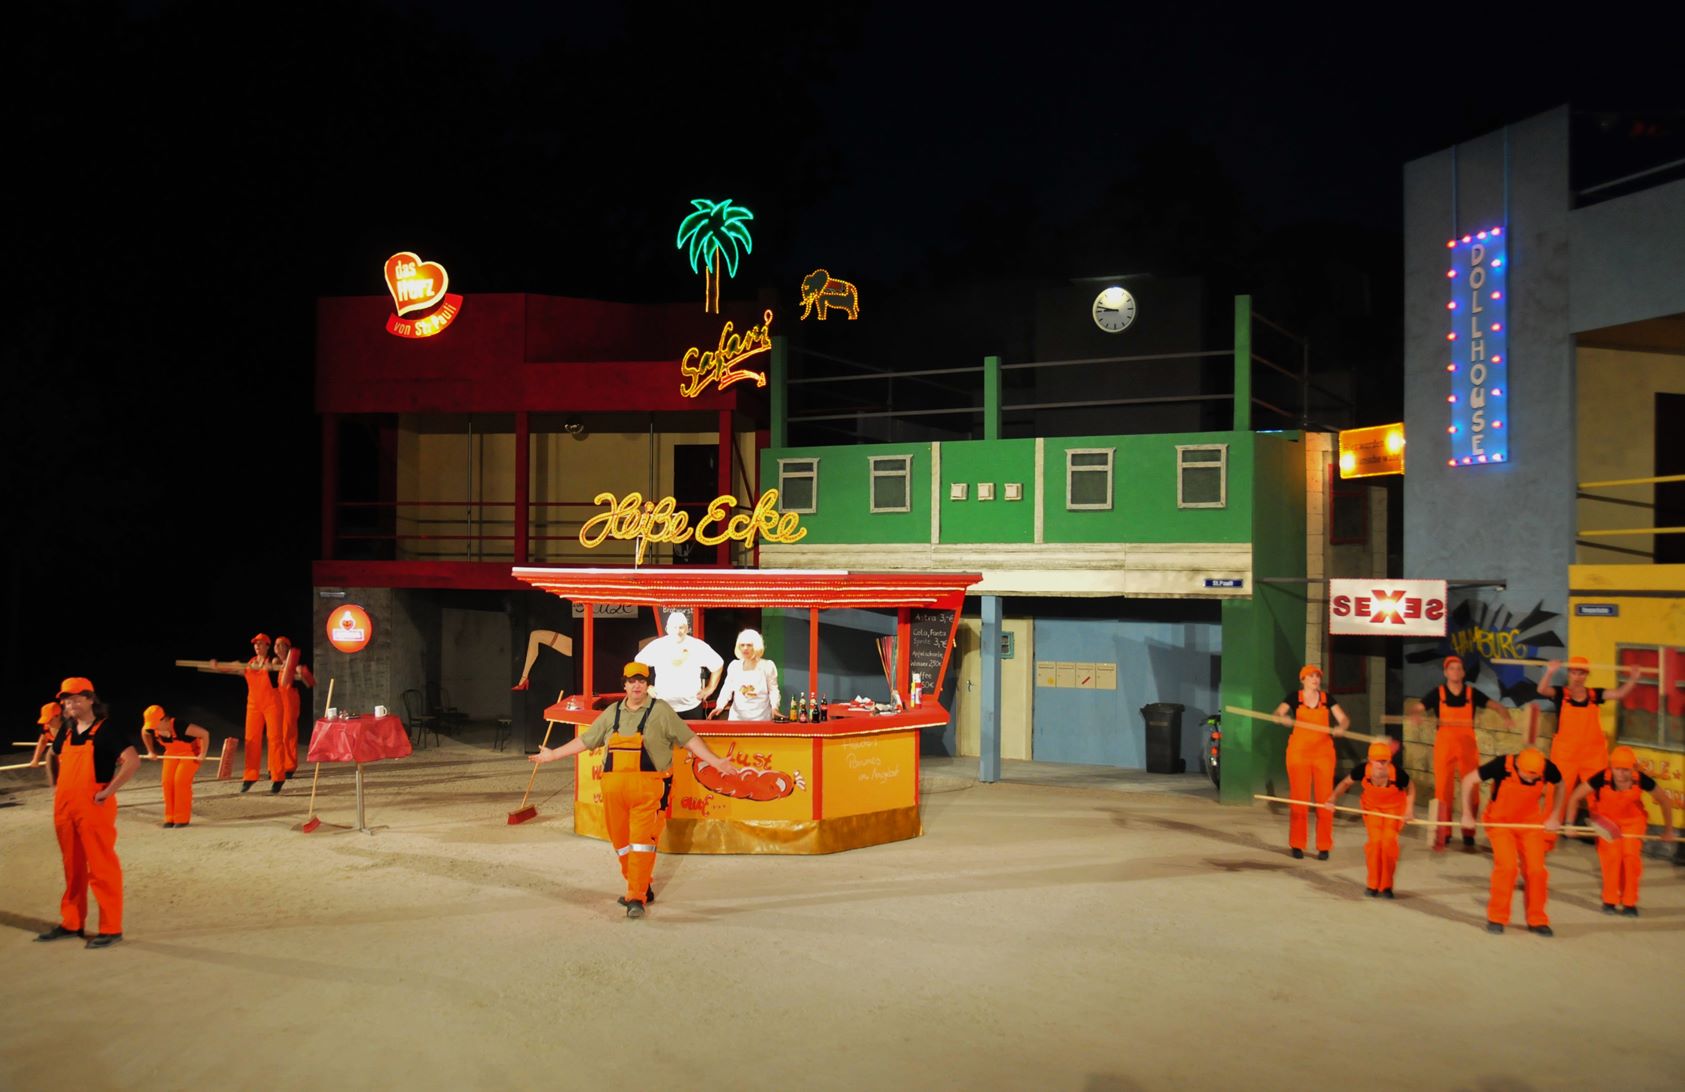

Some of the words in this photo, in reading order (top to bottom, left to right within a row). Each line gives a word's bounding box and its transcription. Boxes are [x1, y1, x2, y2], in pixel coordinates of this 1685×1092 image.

[395, 260, 417, 279] das
[393, 321, 412, 336] von
[680, 310, 772, 397] Safari
[1469, 243, 1487, 456] DOLLHOUSE
[579, 492, 694, 565] Heiße
[695, 489, 808, 549] Ecke
[1452, 626, 1528, 660] HAMBURG
[727, 742, 772, 771] Lust
